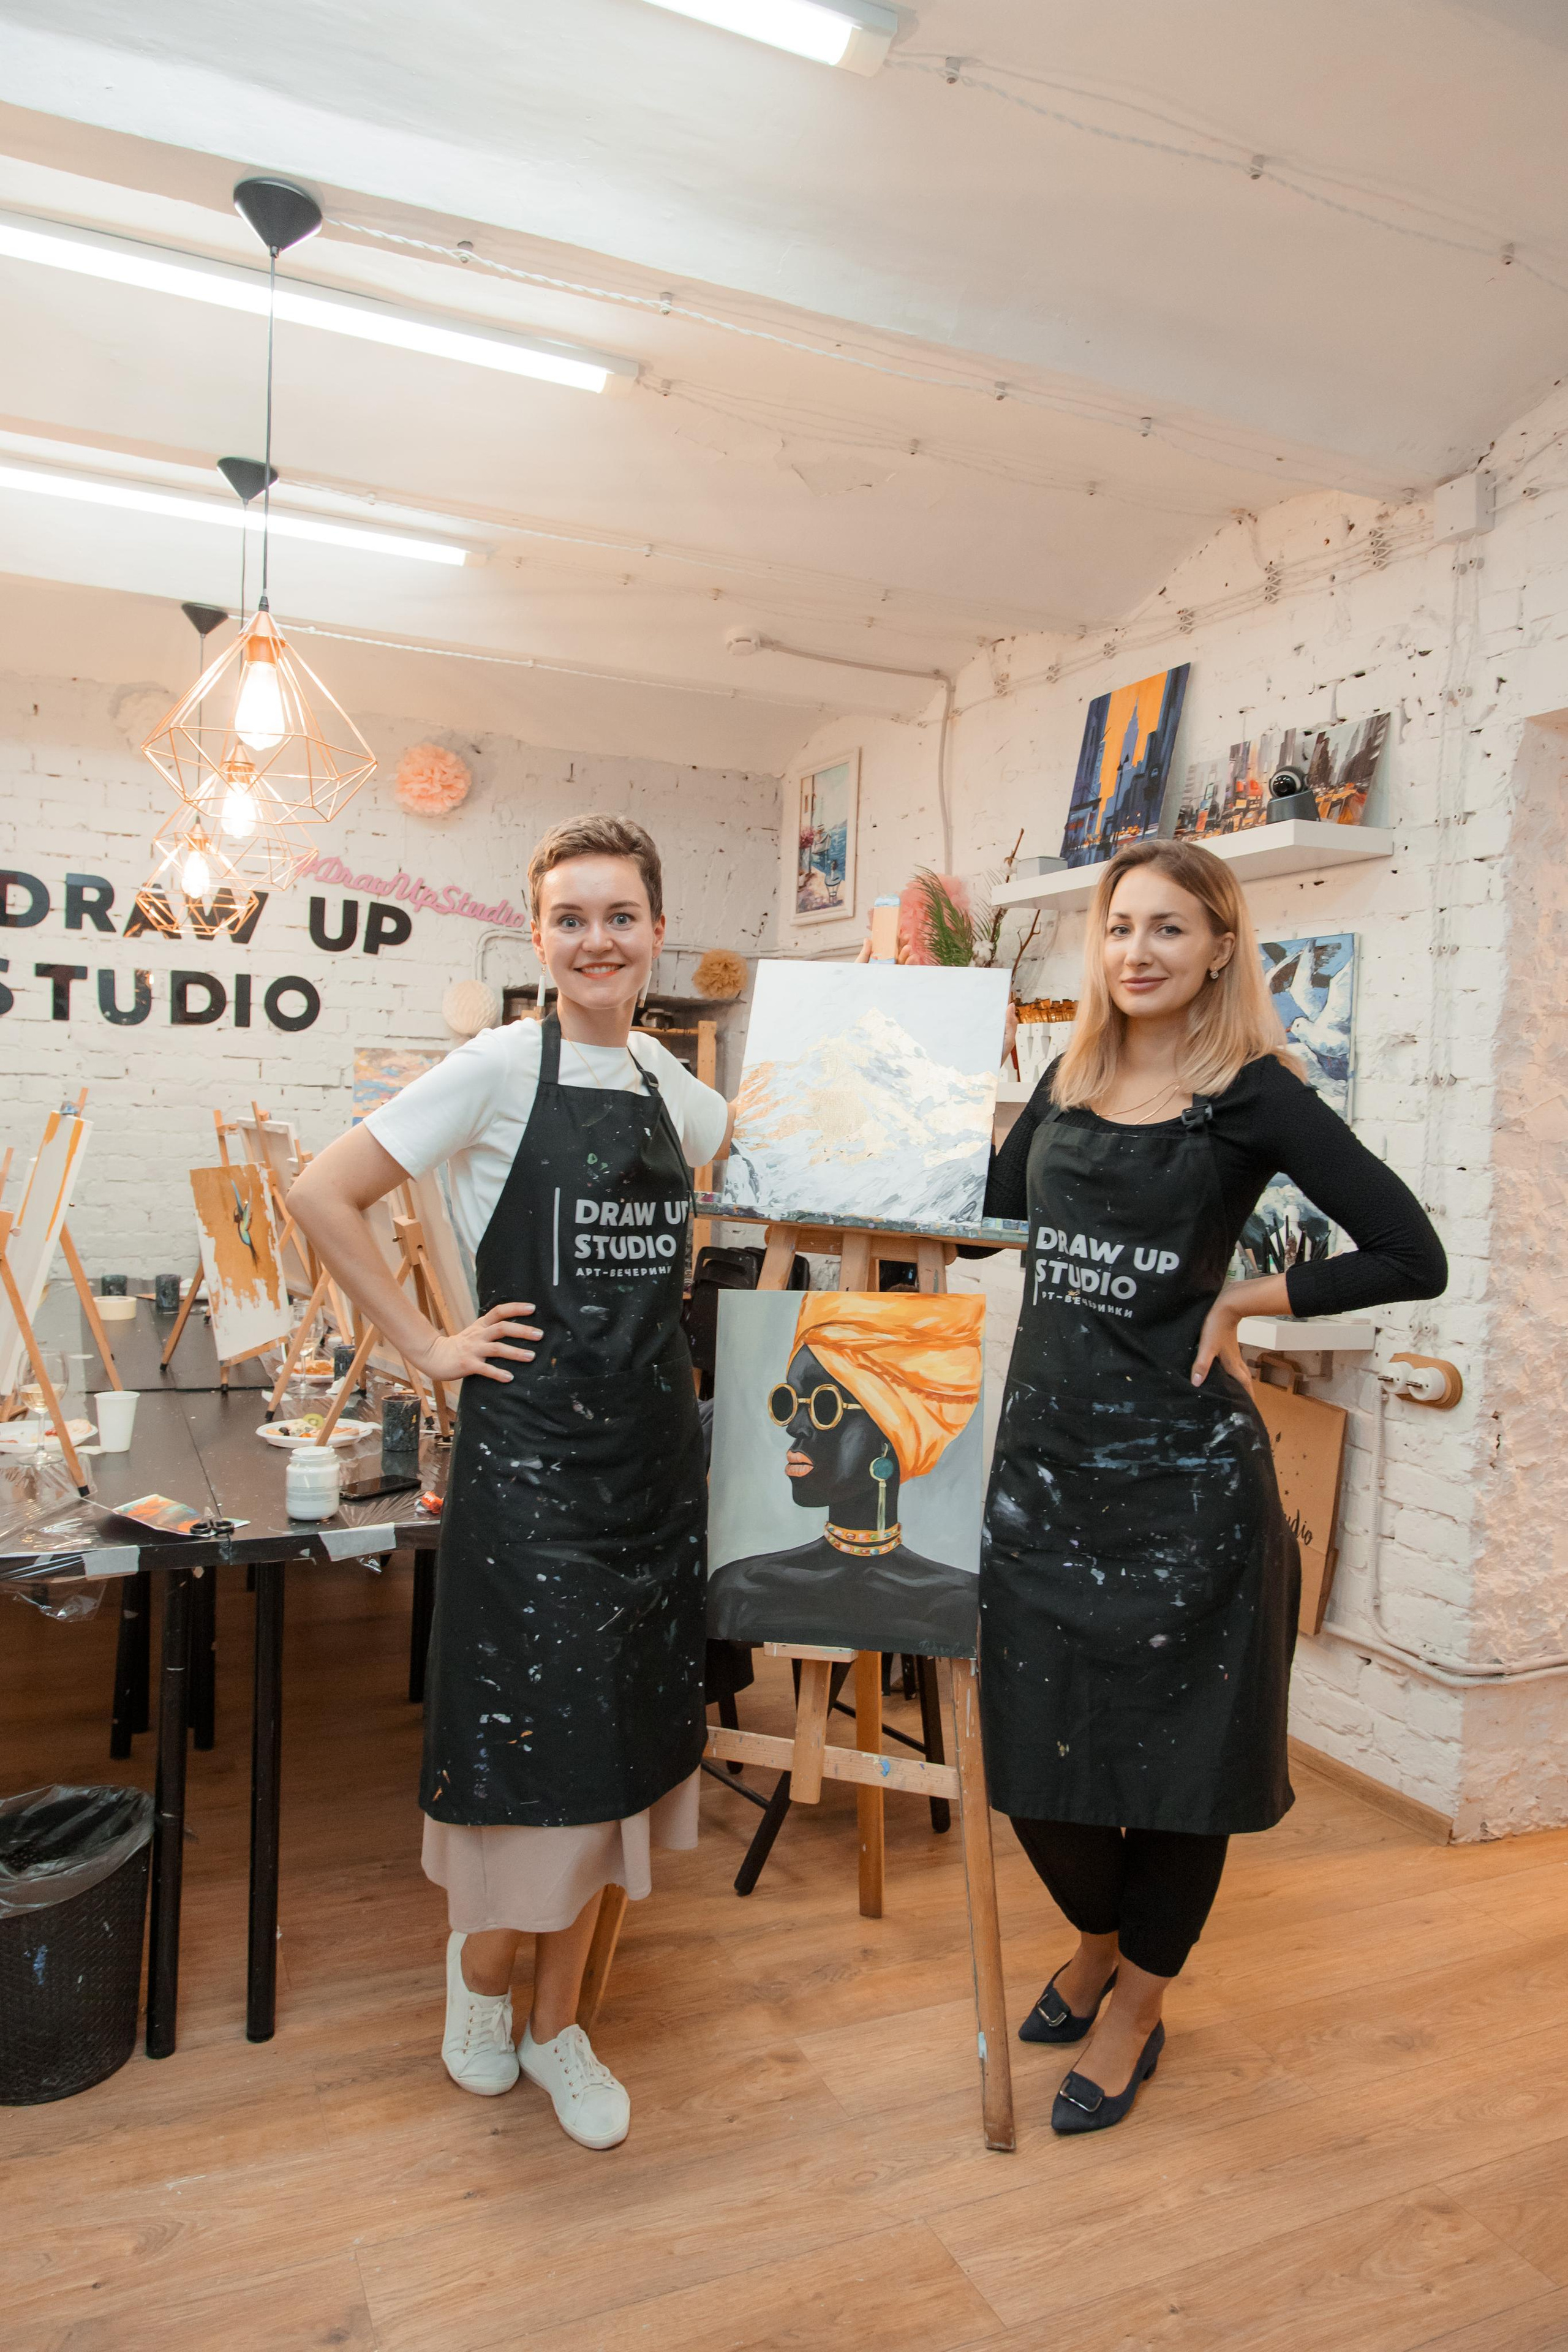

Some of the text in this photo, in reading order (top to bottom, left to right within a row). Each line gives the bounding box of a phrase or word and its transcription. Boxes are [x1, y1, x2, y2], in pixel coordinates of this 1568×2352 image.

[0, 869, 412, 955] DRAW UP
[0, 959, 320, 1031] TUDIO
[575, 1199, 657, 1226] DRAW
[574, 1234, 677, 1260] STUDIO
[1036, 1226, 1180, 1274] DRAW UP
[1035, 1259, 1137, 1300] STUDIO
[1042, 1291, 1133, 1318] РТ-ВЕЧЕРИНКИ
